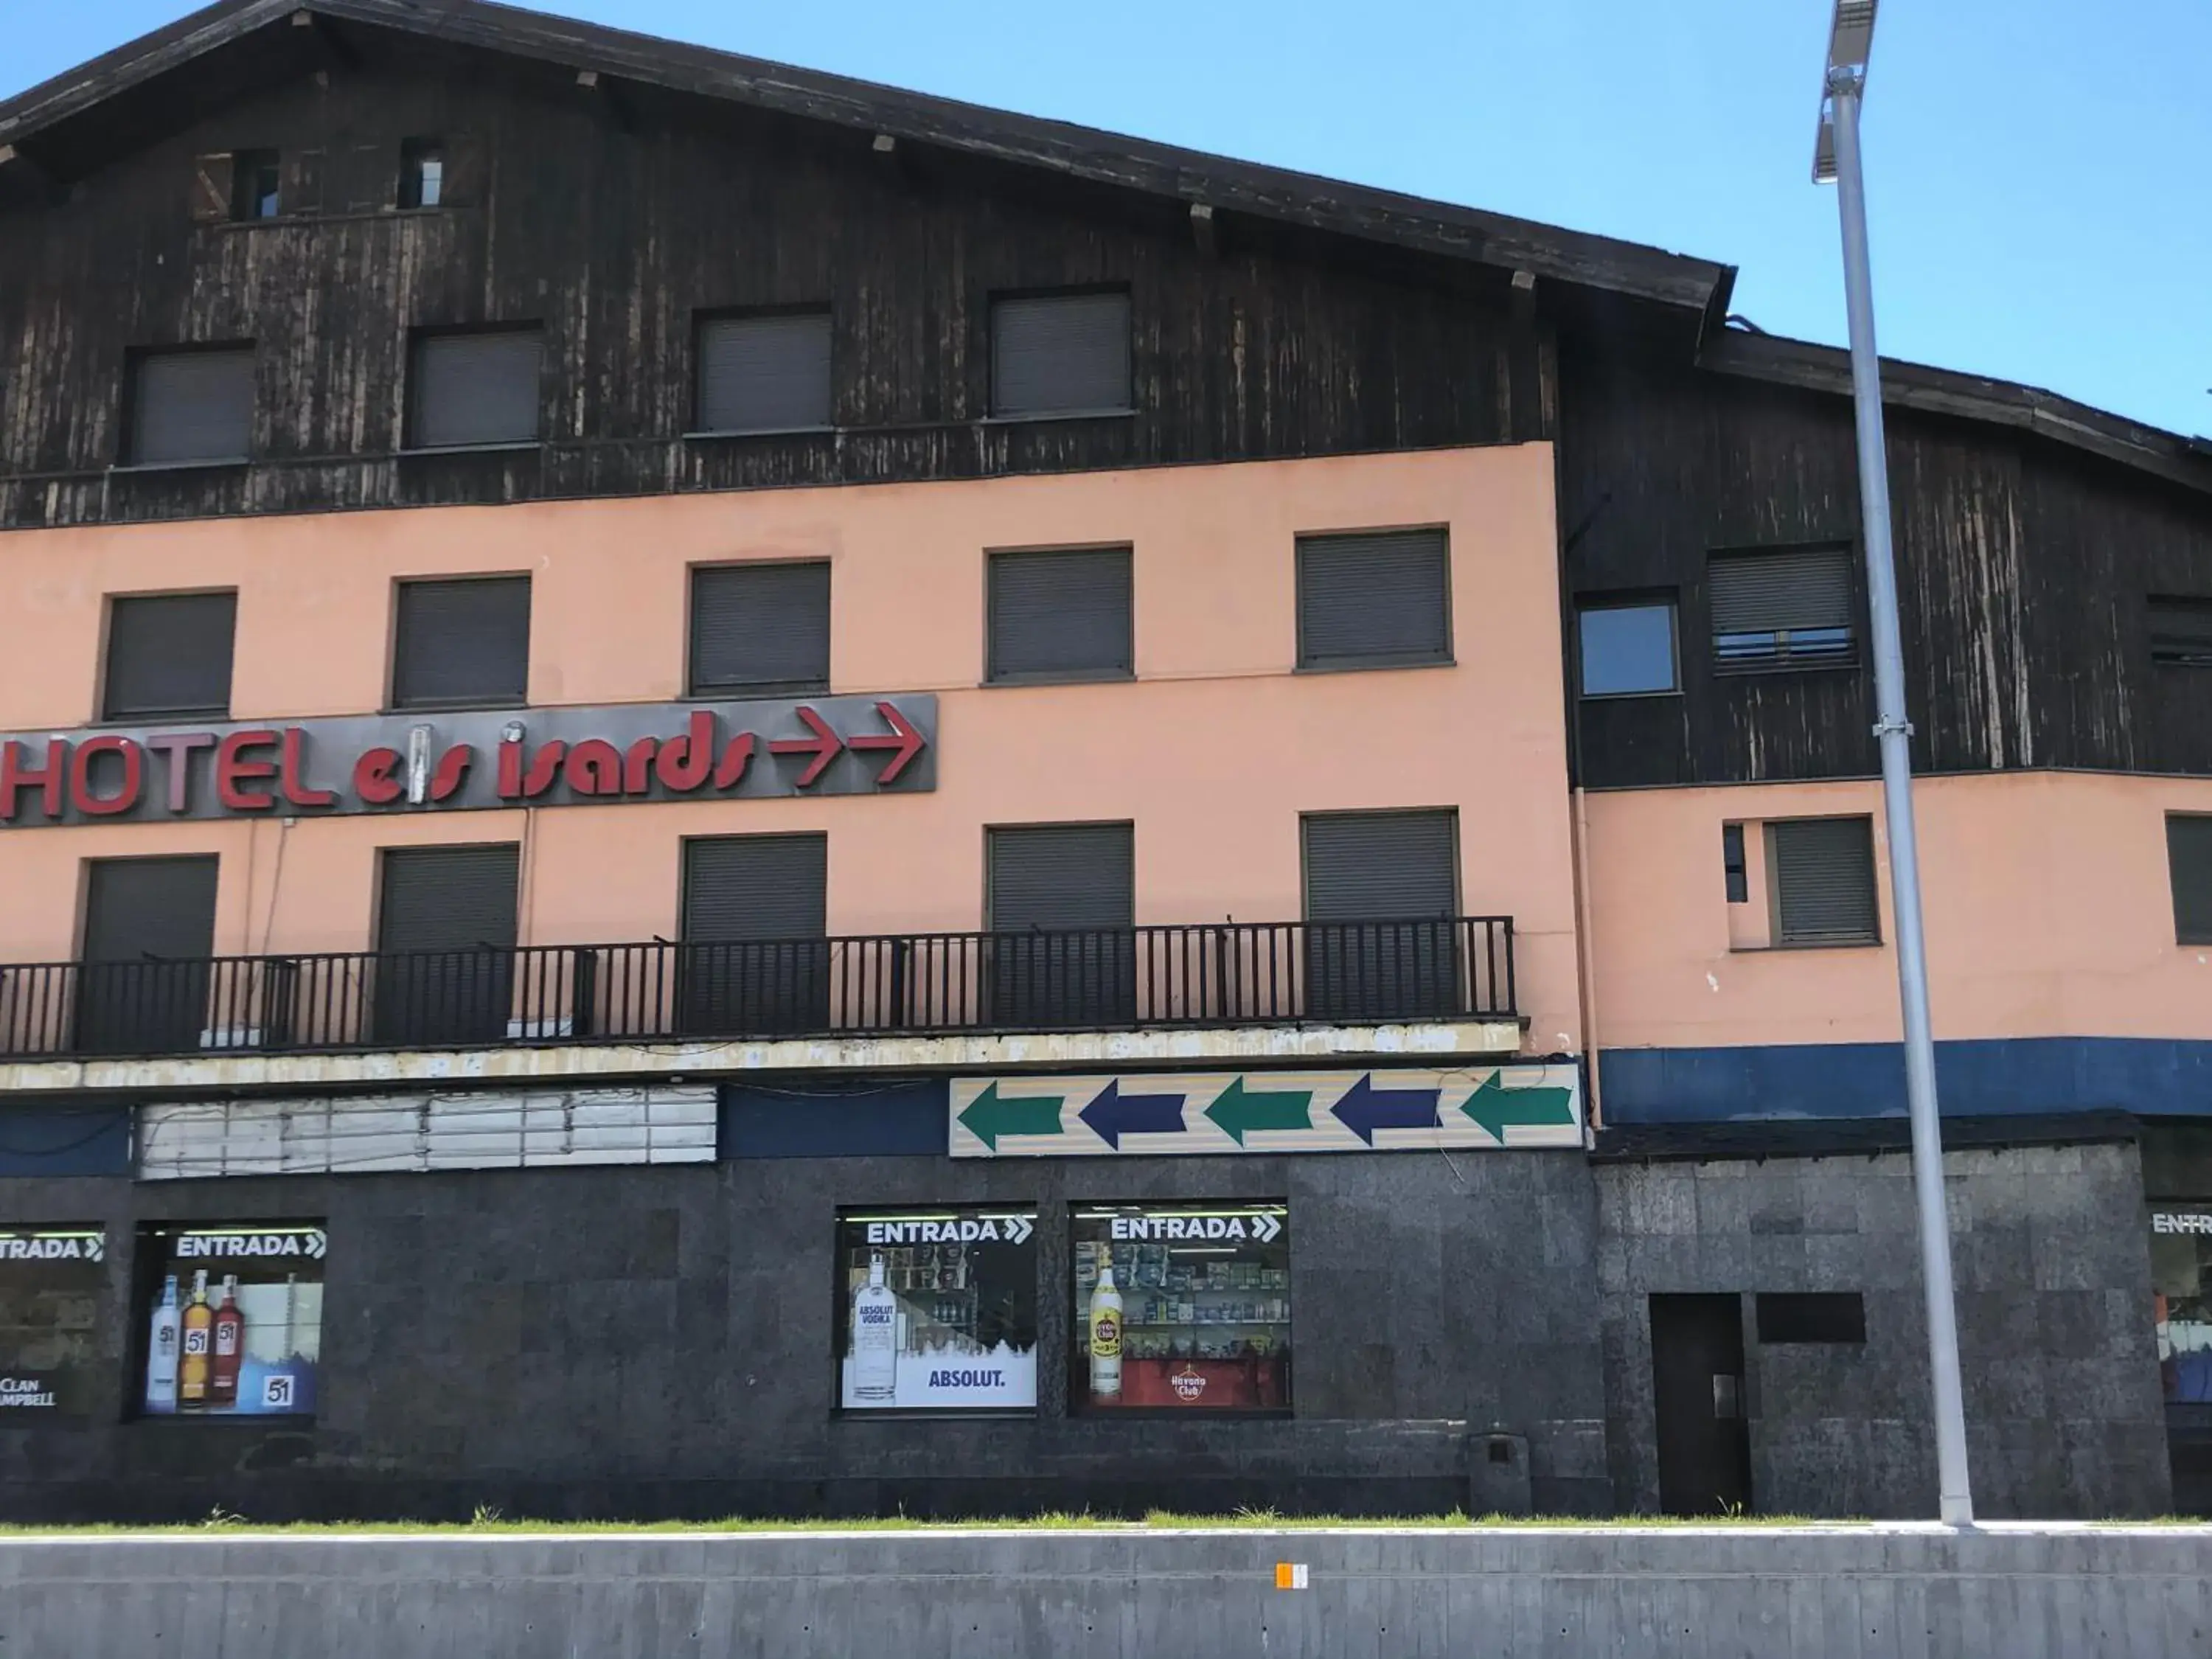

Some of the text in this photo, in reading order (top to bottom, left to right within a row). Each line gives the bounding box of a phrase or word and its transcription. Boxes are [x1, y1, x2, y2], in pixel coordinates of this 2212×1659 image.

[0, 709, 757, 819] HOTEL els isards
[866, 1220, 1000, 1244] ENTRADA
[1111, 1217, 1248, 1239] ENTRADA
[176, 1235, 300, 1257] ENTRADA
[859, 1305, 894, 1315] ABSOLUT
[159, 1326, 175, 1343] 51
[187, 1332, 206, 1352] 51
[218, 1324, 234, 1340] 51
[928, 1369, 1006, 1387] ABSOLUT.
[267, 1378, 289, 1402] 51
